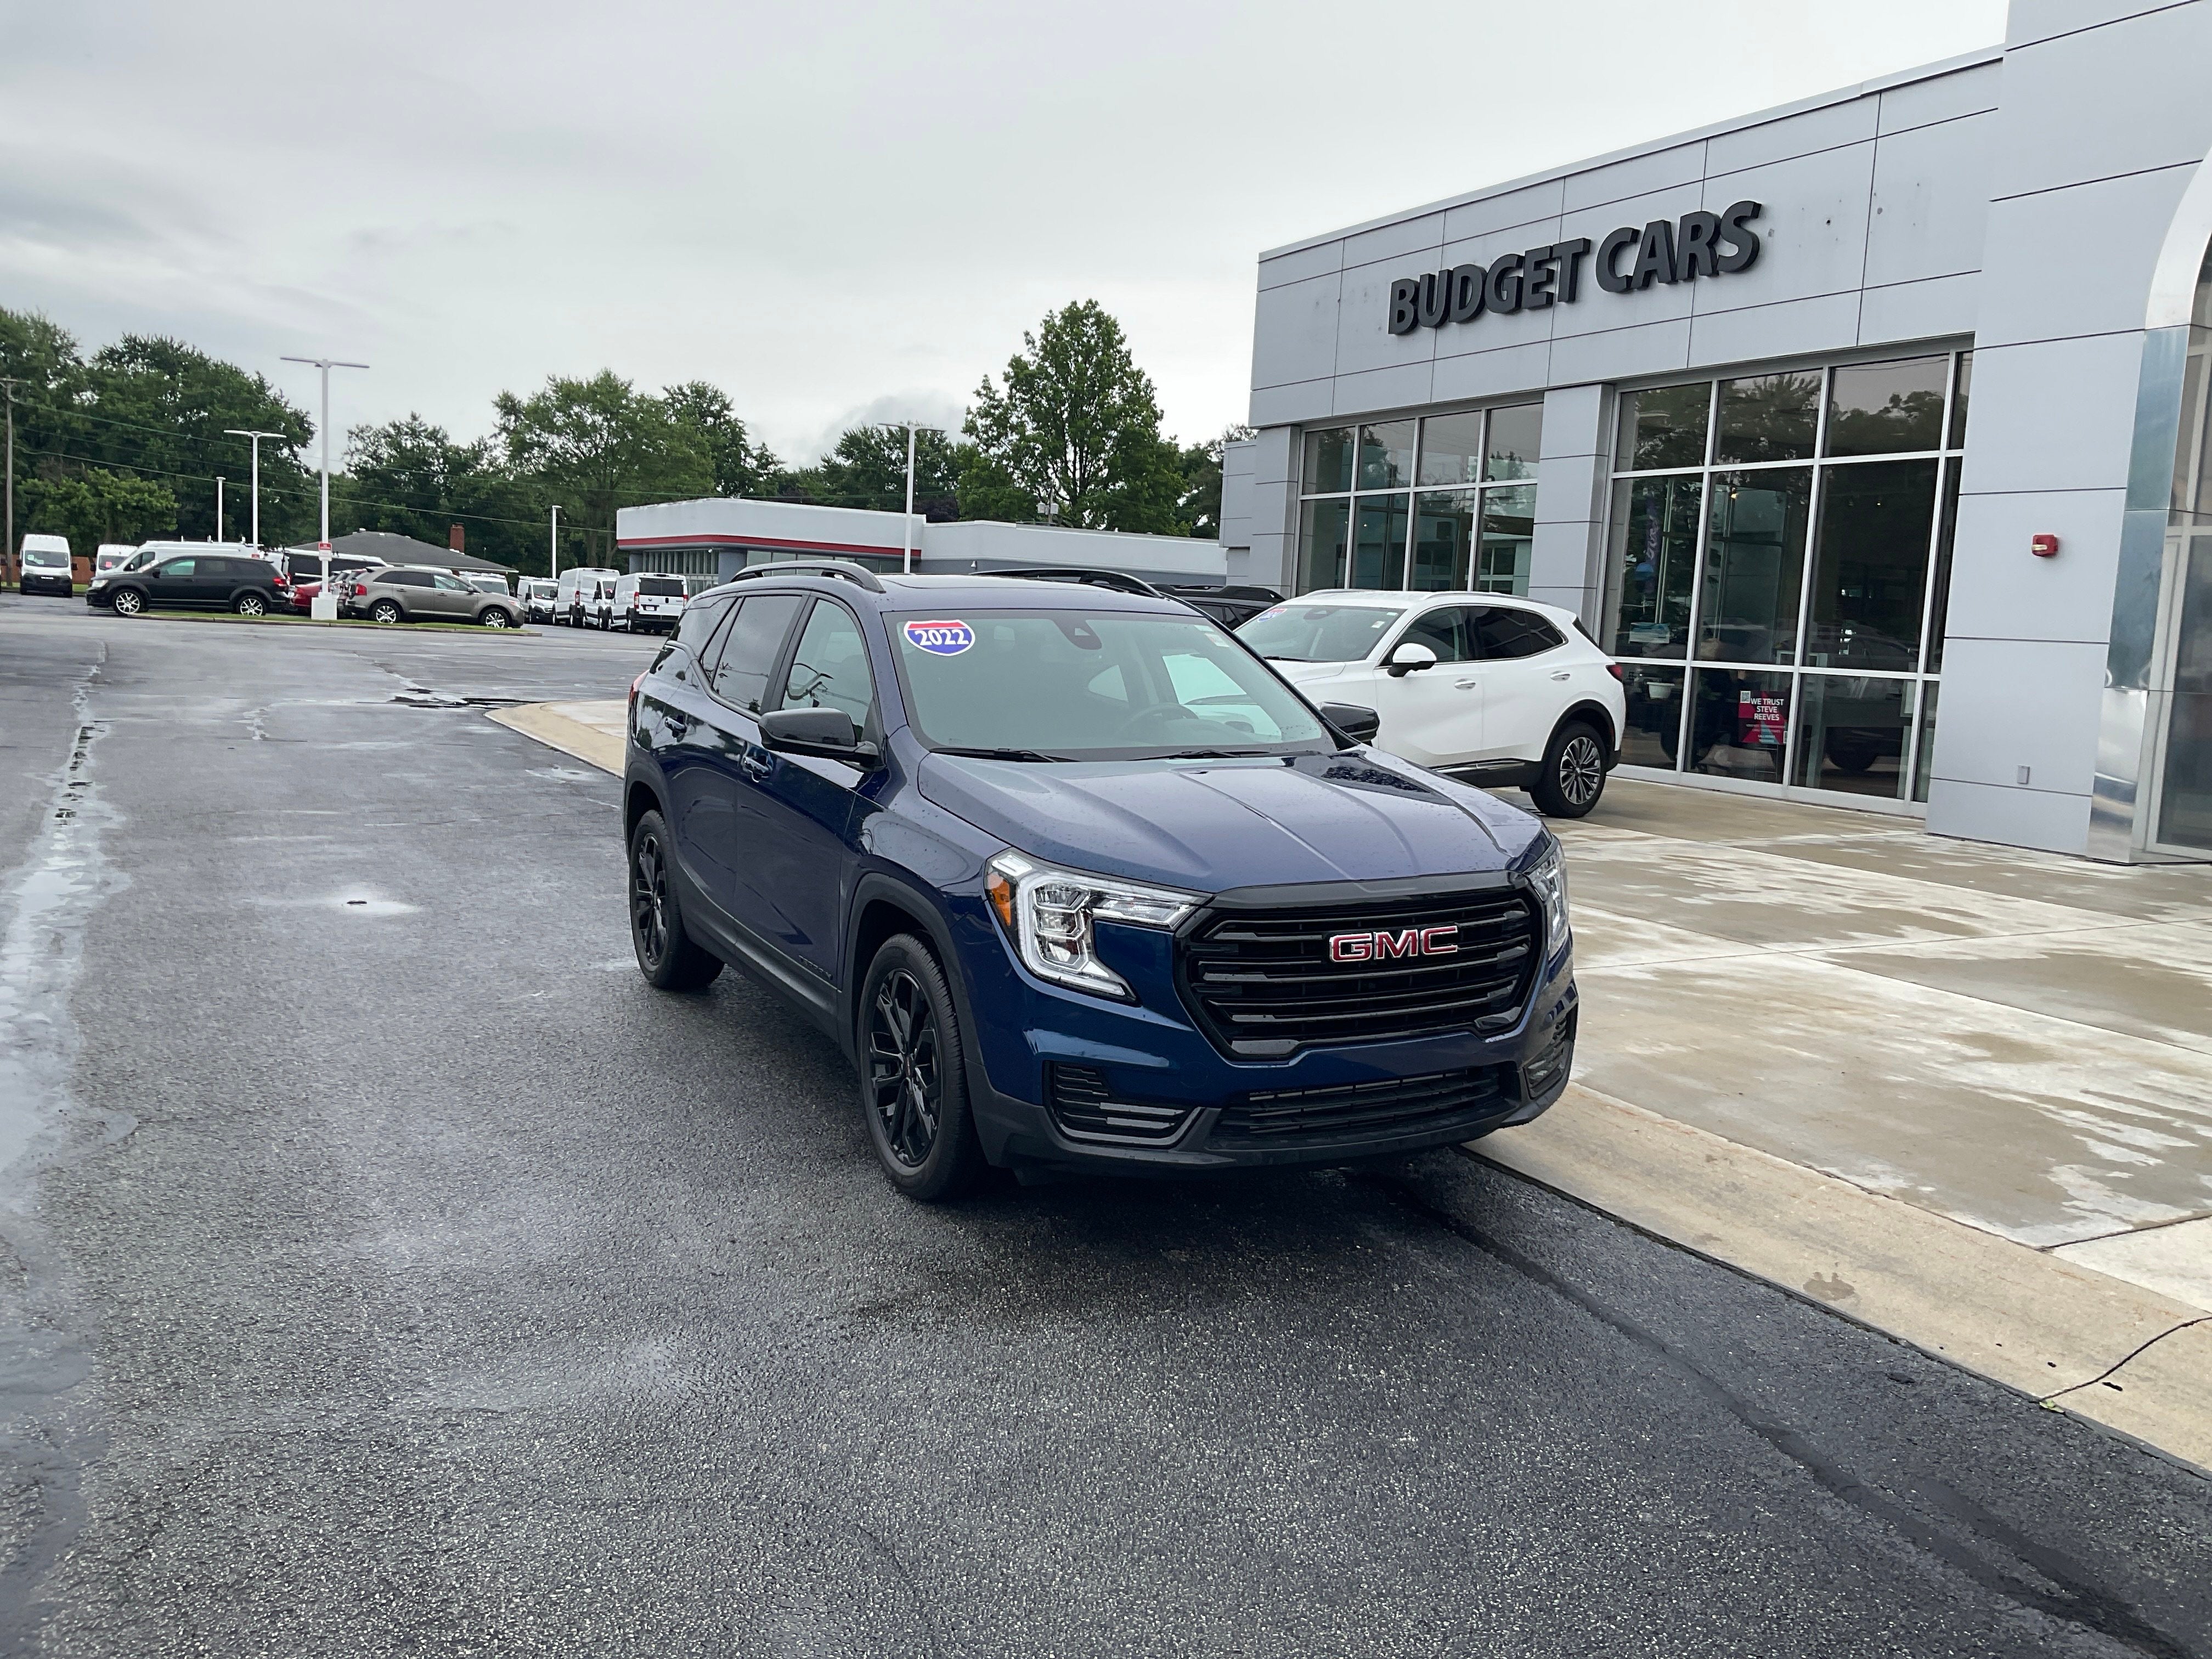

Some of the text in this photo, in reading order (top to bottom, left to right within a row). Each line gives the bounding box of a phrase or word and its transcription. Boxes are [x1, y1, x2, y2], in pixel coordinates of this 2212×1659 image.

[1388, 200, 1762, 335] BUDGET CARS
[914, 629, 969, 646] 2022
[1329, 925, 1458, 962] GMC
